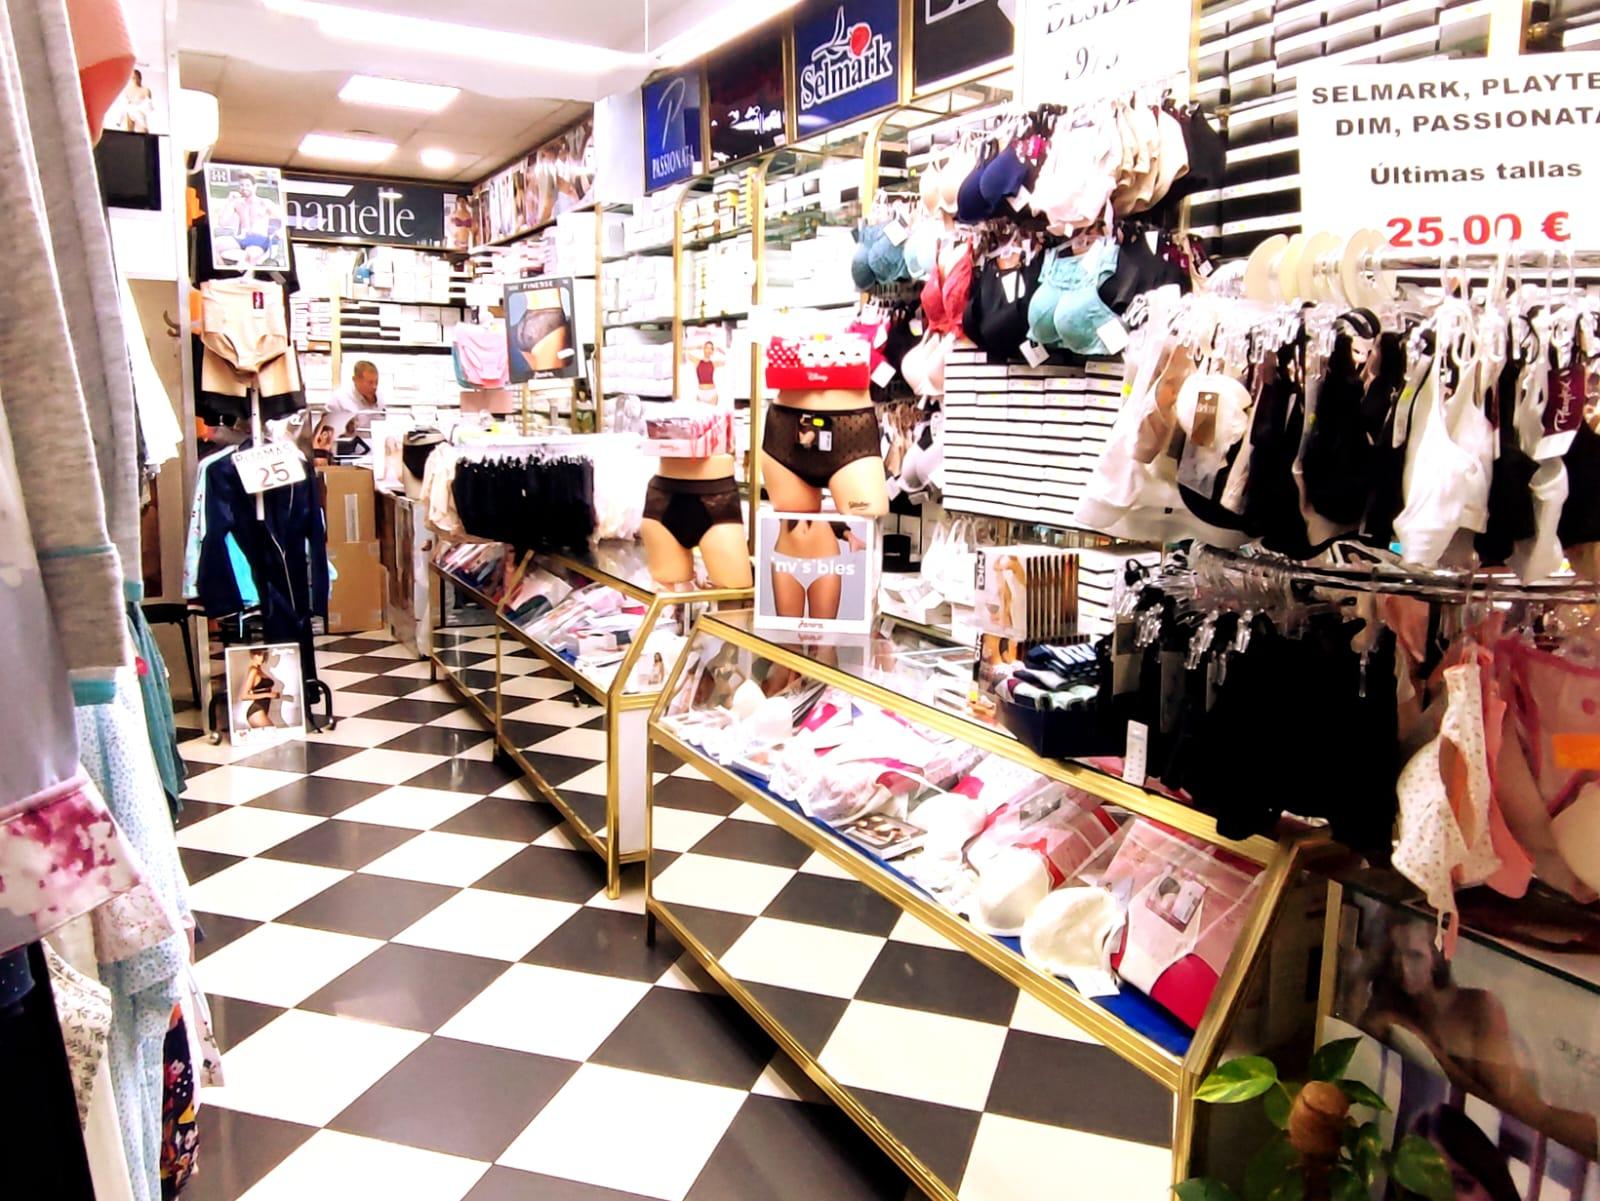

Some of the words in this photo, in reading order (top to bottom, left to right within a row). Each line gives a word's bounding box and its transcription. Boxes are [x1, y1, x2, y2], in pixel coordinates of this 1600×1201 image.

[801, 35, 892, 109] Selmark
[1311, 80, 1470, 104] SELMARK,
[1336, 116, 1401, 137] DIM,
[1412, 106, 1600, 132] PASSIONAT
[652, 144, 695, 180] PASSIONATA
[1370, 162, 1485, 185] Últimas
[1496, 160, 1582, 180] tallas
[1540, 211, 1572, 243] €
[258, 461, 290, 488] 25
[976, 552, 985, 588] DIM
